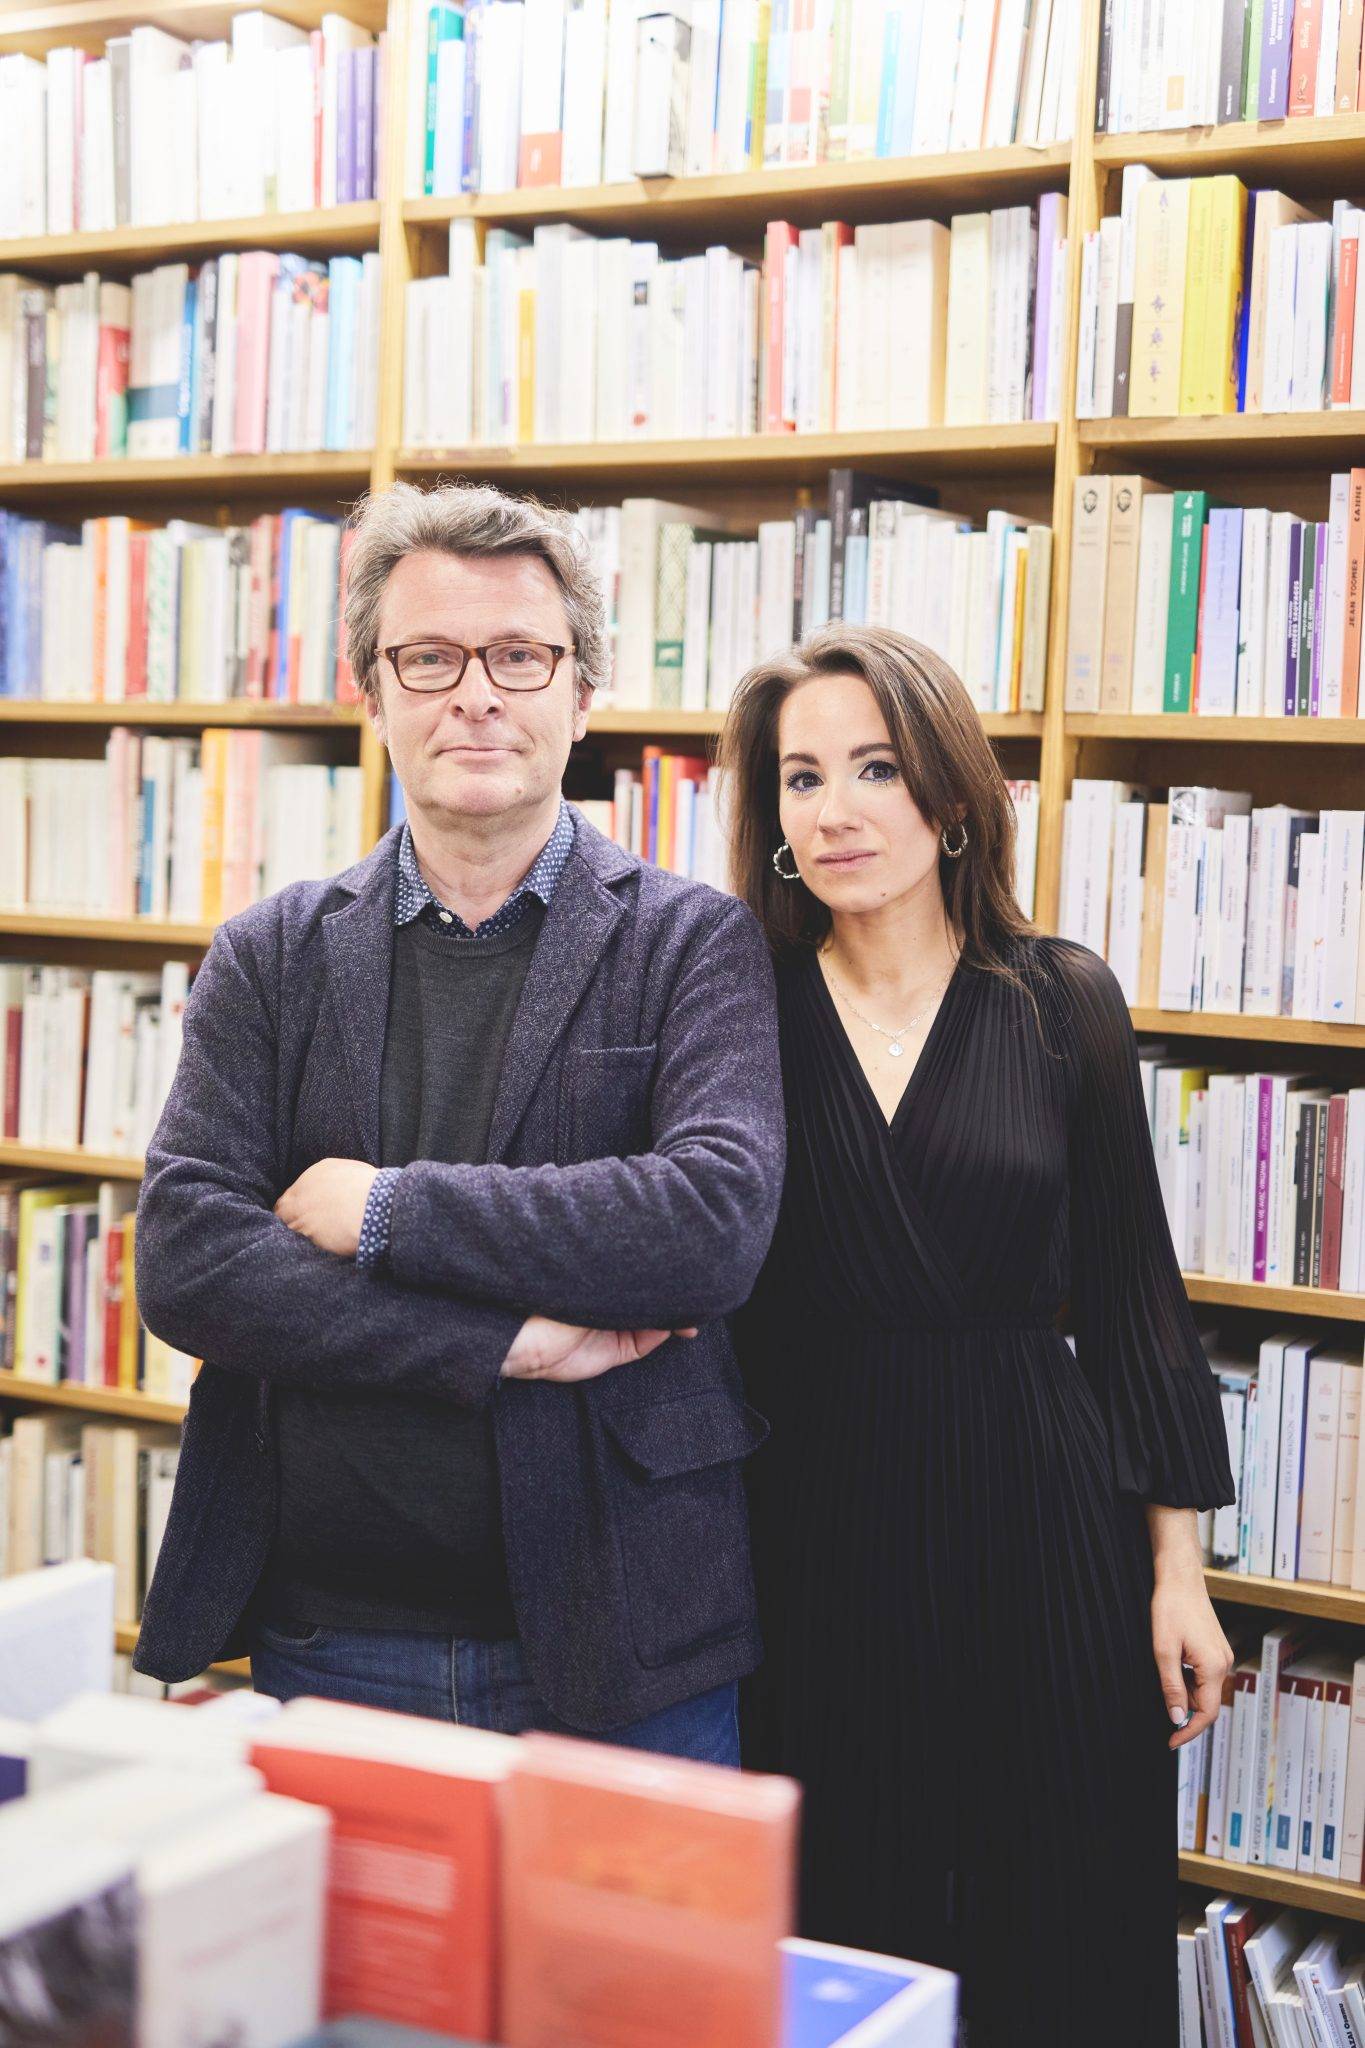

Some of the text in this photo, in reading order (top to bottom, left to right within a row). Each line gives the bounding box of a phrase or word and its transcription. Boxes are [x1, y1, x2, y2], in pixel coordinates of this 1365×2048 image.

[1268, 68, 1278, 104] Flammarion
[1354, 484, 1362, 522] CANNE
[1348, 559, 1358, 627] JEAN TOOMER
[1338, 2002, 1350, 2030] Osamu
